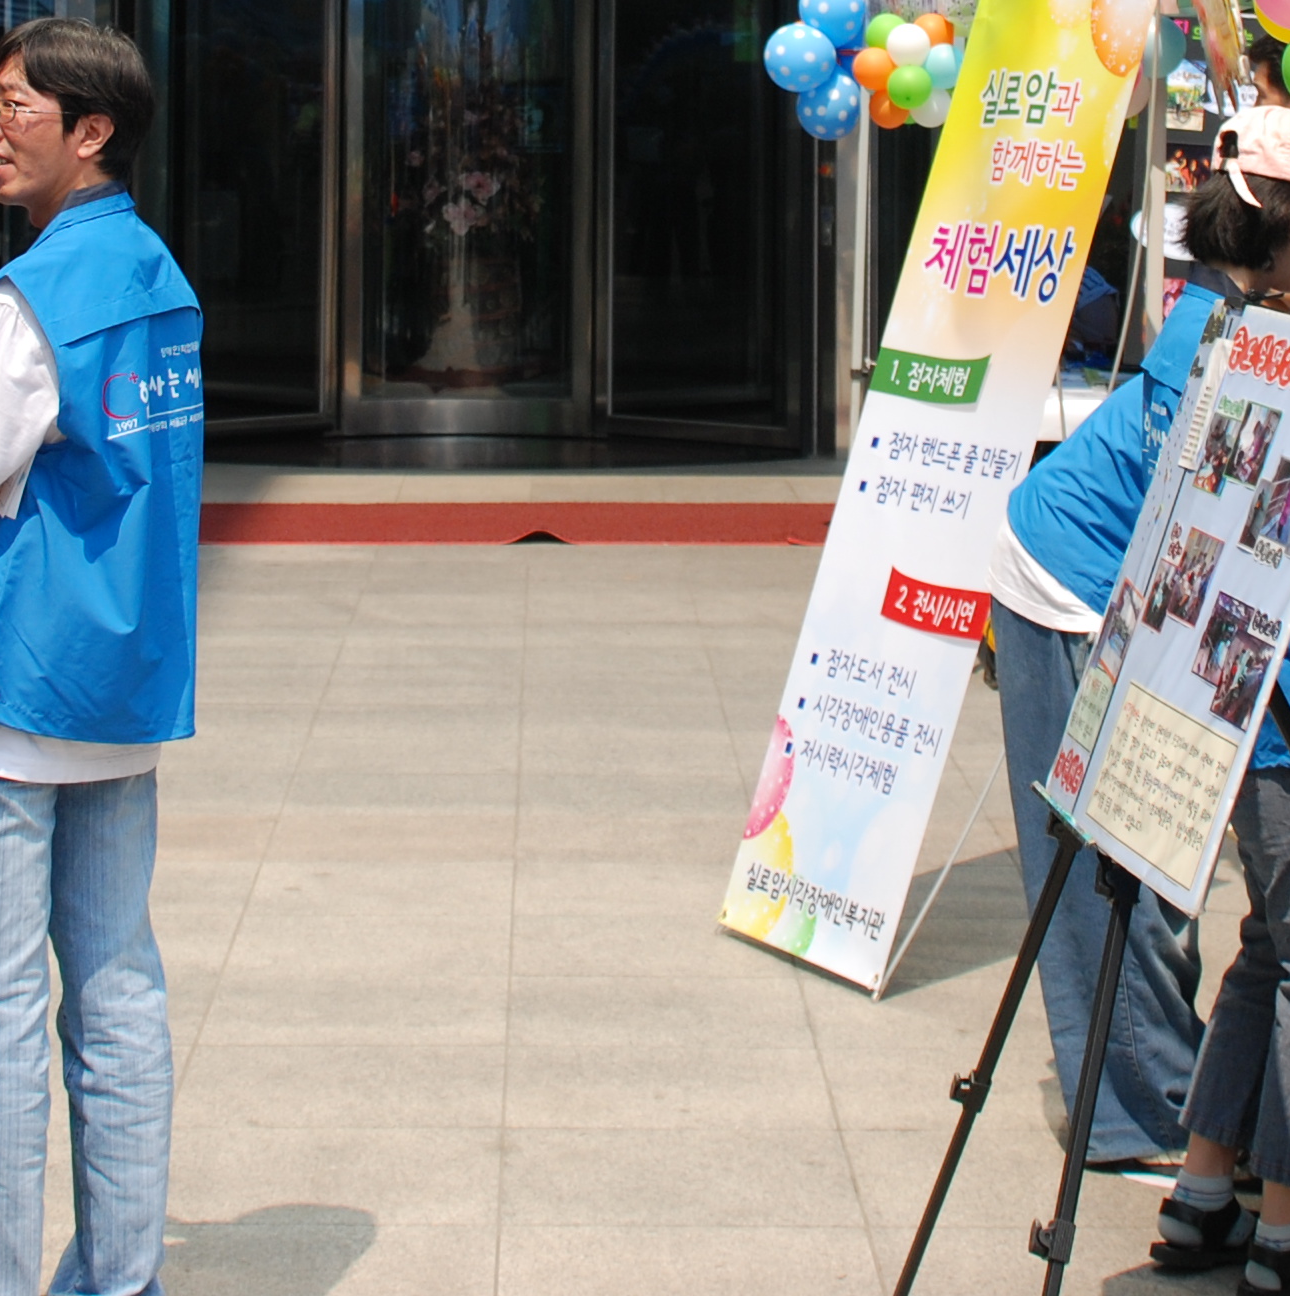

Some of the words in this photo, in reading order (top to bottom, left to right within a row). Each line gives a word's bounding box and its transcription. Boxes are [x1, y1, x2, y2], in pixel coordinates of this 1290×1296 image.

[980, 68, 1083, 127] 실로암과
[990, 139, 1086, 190] 함께하는
[924, 220, 1076, 304] 체험세상
[889, 359, 901, 385] 1.
[907, 361, 972, 397] 점자체험
[115, 418, 138, 432] 1997
[888, 431, 919, 461] 점자
[921, 435, 962, 472] 핸드폰
[964, 443, 980, 474] 줄
[981, 446, 1023, 481] 만들기
[875, 475, 907, 506] 점자
[910, 482, 939, 512] 편지
[940, 488, 974, 520] 쓰기
[894, 584, 908, 614] 2.
[912, 588, 977, 633] 전시/시연
[827, 648, 886, 690] 점자도서
[888, 666, 918, 699] 전시
[813, 694, 910, 750] 시각장애인용품
[914, 722, 944, 758] 전시
[800, 739, 899, 796] 저시력시각체험
[746, 861, 886, 942] 실로암시각장애인복지관
